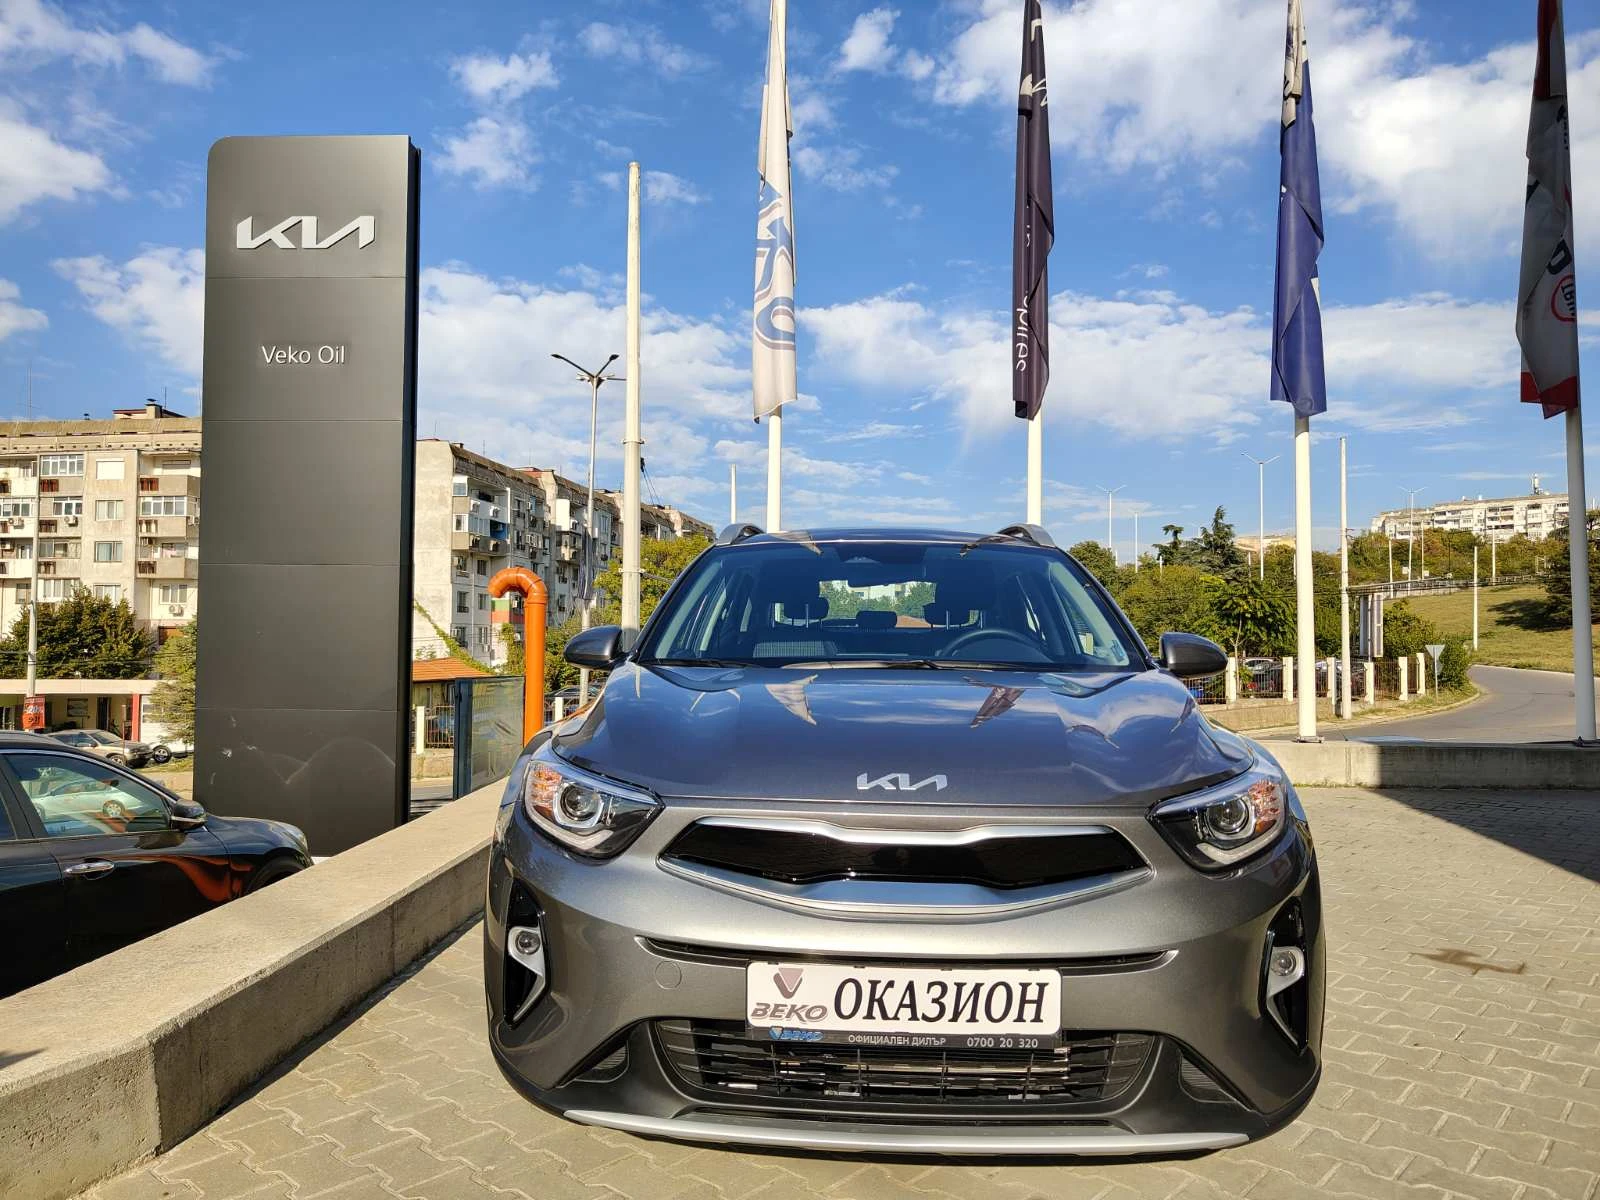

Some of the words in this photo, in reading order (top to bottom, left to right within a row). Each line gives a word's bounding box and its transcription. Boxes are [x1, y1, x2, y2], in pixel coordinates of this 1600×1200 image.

[236, 215, 376, 250] KIA
[261, 345, 312, 364] Veko
[318, 345, 346, 364] Oil
[856, 772, 948, 792] KIA
[833, 977, 1050, 1024] ОКАЗИОН
[848, 1034, 910, 1046] ОФИЦИАЛЕН
[911, 1037, 947, 1047] ДИЛЪР
[966, 1037, 995, 1048] 0700
[999, 1037, 1013, 1049] 20
[1018, 1038, 1039, 1049] 320
